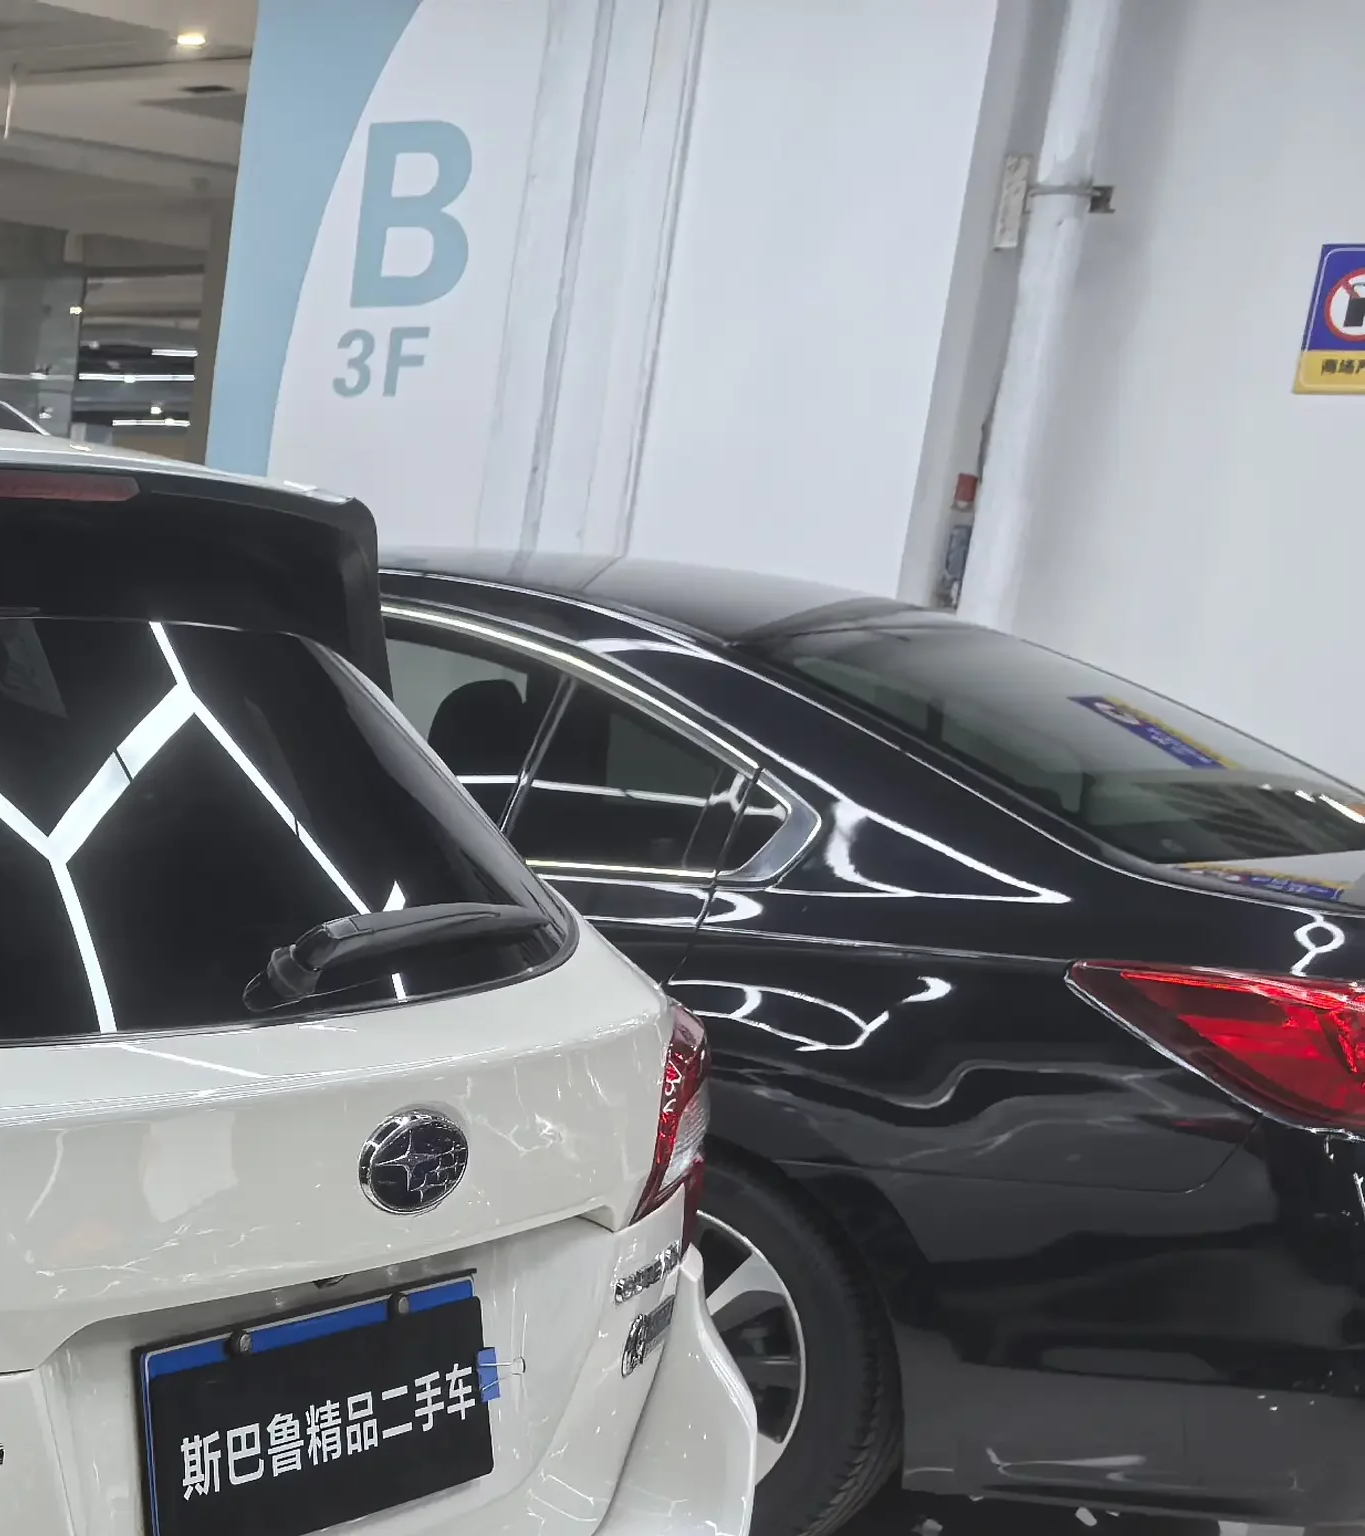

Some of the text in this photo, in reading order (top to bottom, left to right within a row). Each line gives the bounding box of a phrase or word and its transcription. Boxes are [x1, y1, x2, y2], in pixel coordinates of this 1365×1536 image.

[350, 120, 472, 308] B
[332, 326, 430, 398] 3F
[180, 1363, 476, 1500] 斯巴鲁精品二手车
